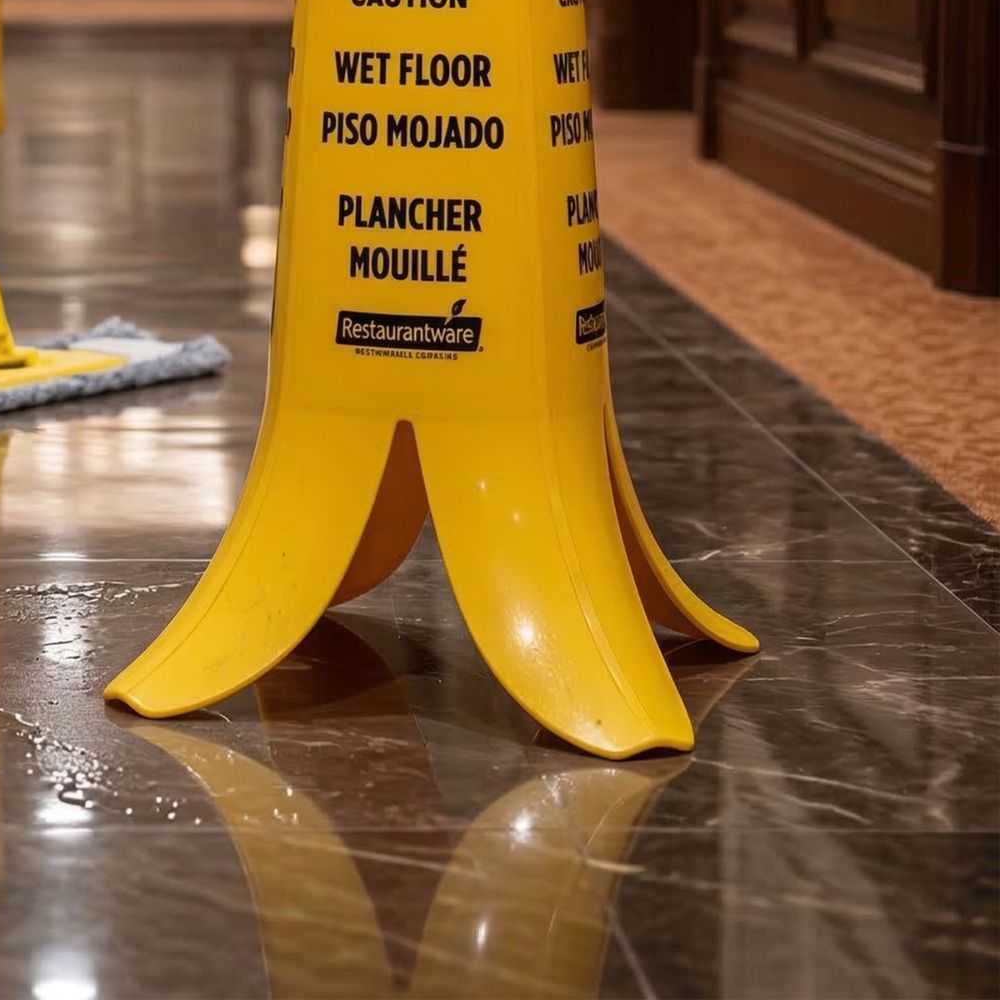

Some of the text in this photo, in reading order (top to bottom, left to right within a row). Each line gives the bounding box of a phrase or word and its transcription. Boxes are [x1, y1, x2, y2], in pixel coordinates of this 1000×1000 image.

[335, 50, 391, 85] WET
[399, 52, 492, 88] FLOOR
[553, 51, 580, 85] WET
[321, 111, 378, 147] PISO
[386, 113, 505, 150] MOJADO
[550, 112, 582, 147] PISO
[337, 193, 483, 232] PLANCHER
[349, 243, 468, 283] MOUILLÉ
[341, 317, 476, 346] Restaurantware
